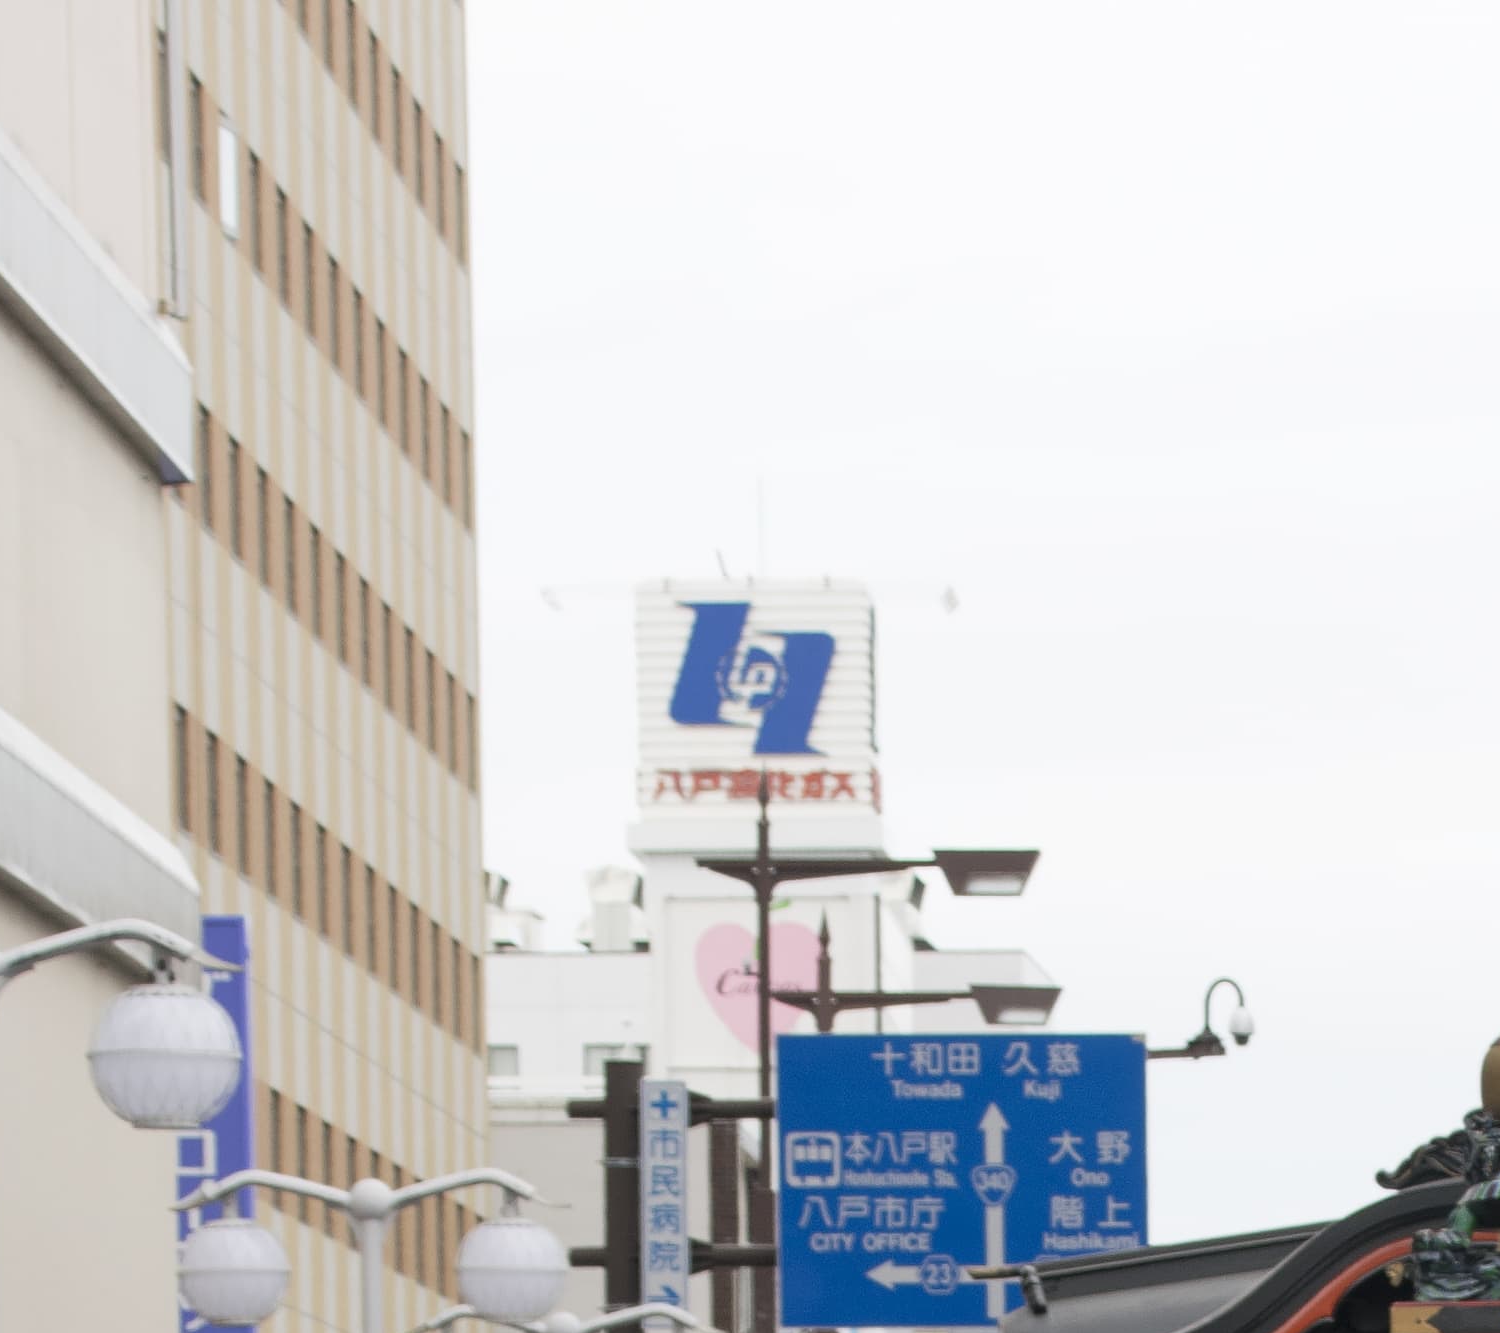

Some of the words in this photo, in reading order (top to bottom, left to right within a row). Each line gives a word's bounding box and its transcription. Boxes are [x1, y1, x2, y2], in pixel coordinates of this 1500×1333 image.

[871, 1041, 980, 1076] 十和田
[1003, 1041, 1081, 1076] 久慈
[889, 1080, 965, 1100] Towada
[1023, 1080, 1062, 1104] Kuji
[844, 1131, 958, 1165] 本八戸駅
[1049, 1130, 1132, 1165] 大野
[974, 1171, 1015, 1192] 340
[1071, 1167, 1111, 1187] Ono
[649, 1128, 681, 1272] 市民病院
[800, 1196, 945, 1231] 八戸市庁
[1050, 1196, 1132, 1230] 階上
[809, 1232, 853, 1253] CITY
[863, 1232, 932, 1253] OFFICE
[1042, 1232, 1141, 1250] Hashikami
[927, 1264, 951, 1285] 23
